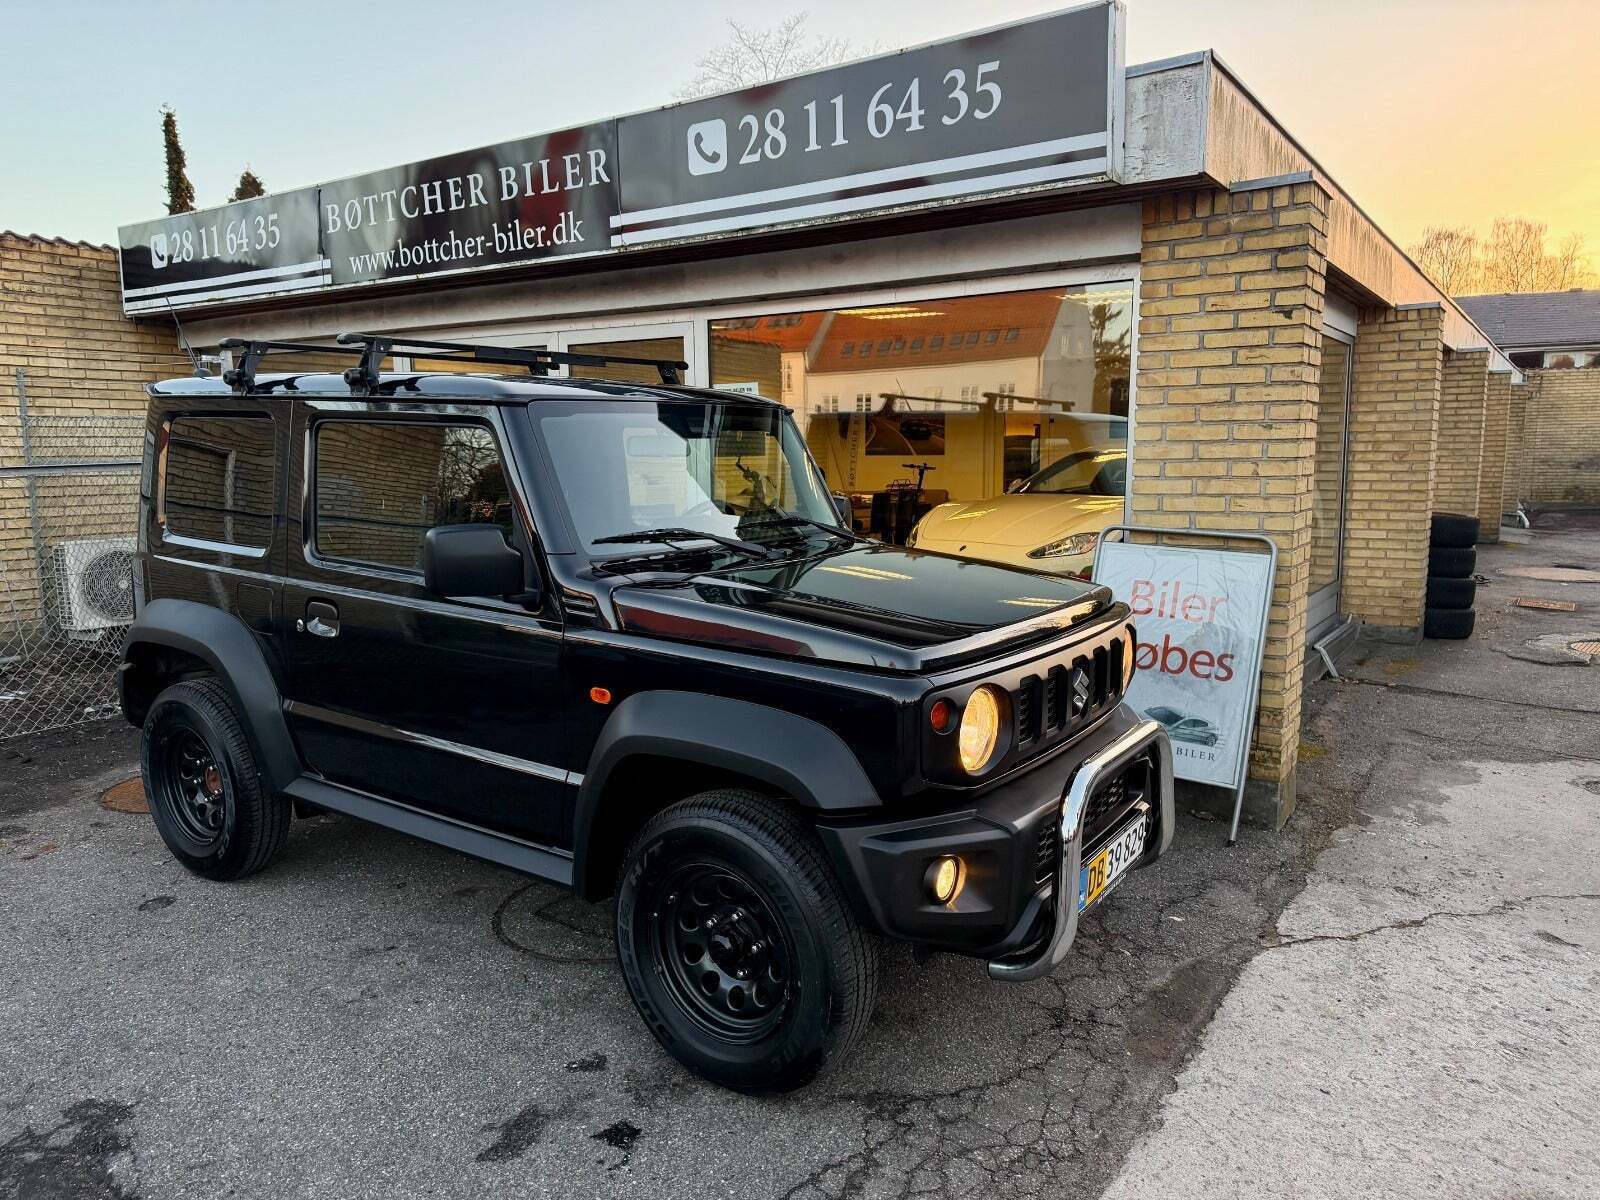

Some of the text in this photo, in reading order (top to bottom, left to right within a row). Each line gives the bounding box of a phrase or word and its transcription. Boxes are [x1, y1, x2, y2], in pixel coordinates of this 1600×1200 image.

[738, 60, 1002, 165] 28 11 64 35
[326, 149, 611, 234] BØTTCHER BILER
[170, 213, 280, 264] 28 11 64 35
[349, 211, 585, 275] www.bottcher-biler.dk
[1131, 580, 1228, 623] Biler
[1136, 634, 1234, 681] øbes
[1176, 746, 1216, 762] BILER
[1088, 857, 1105, 896] DB
[1106, 842, 1122, 879] 39
[1123, 821, 1145, 863] 829
